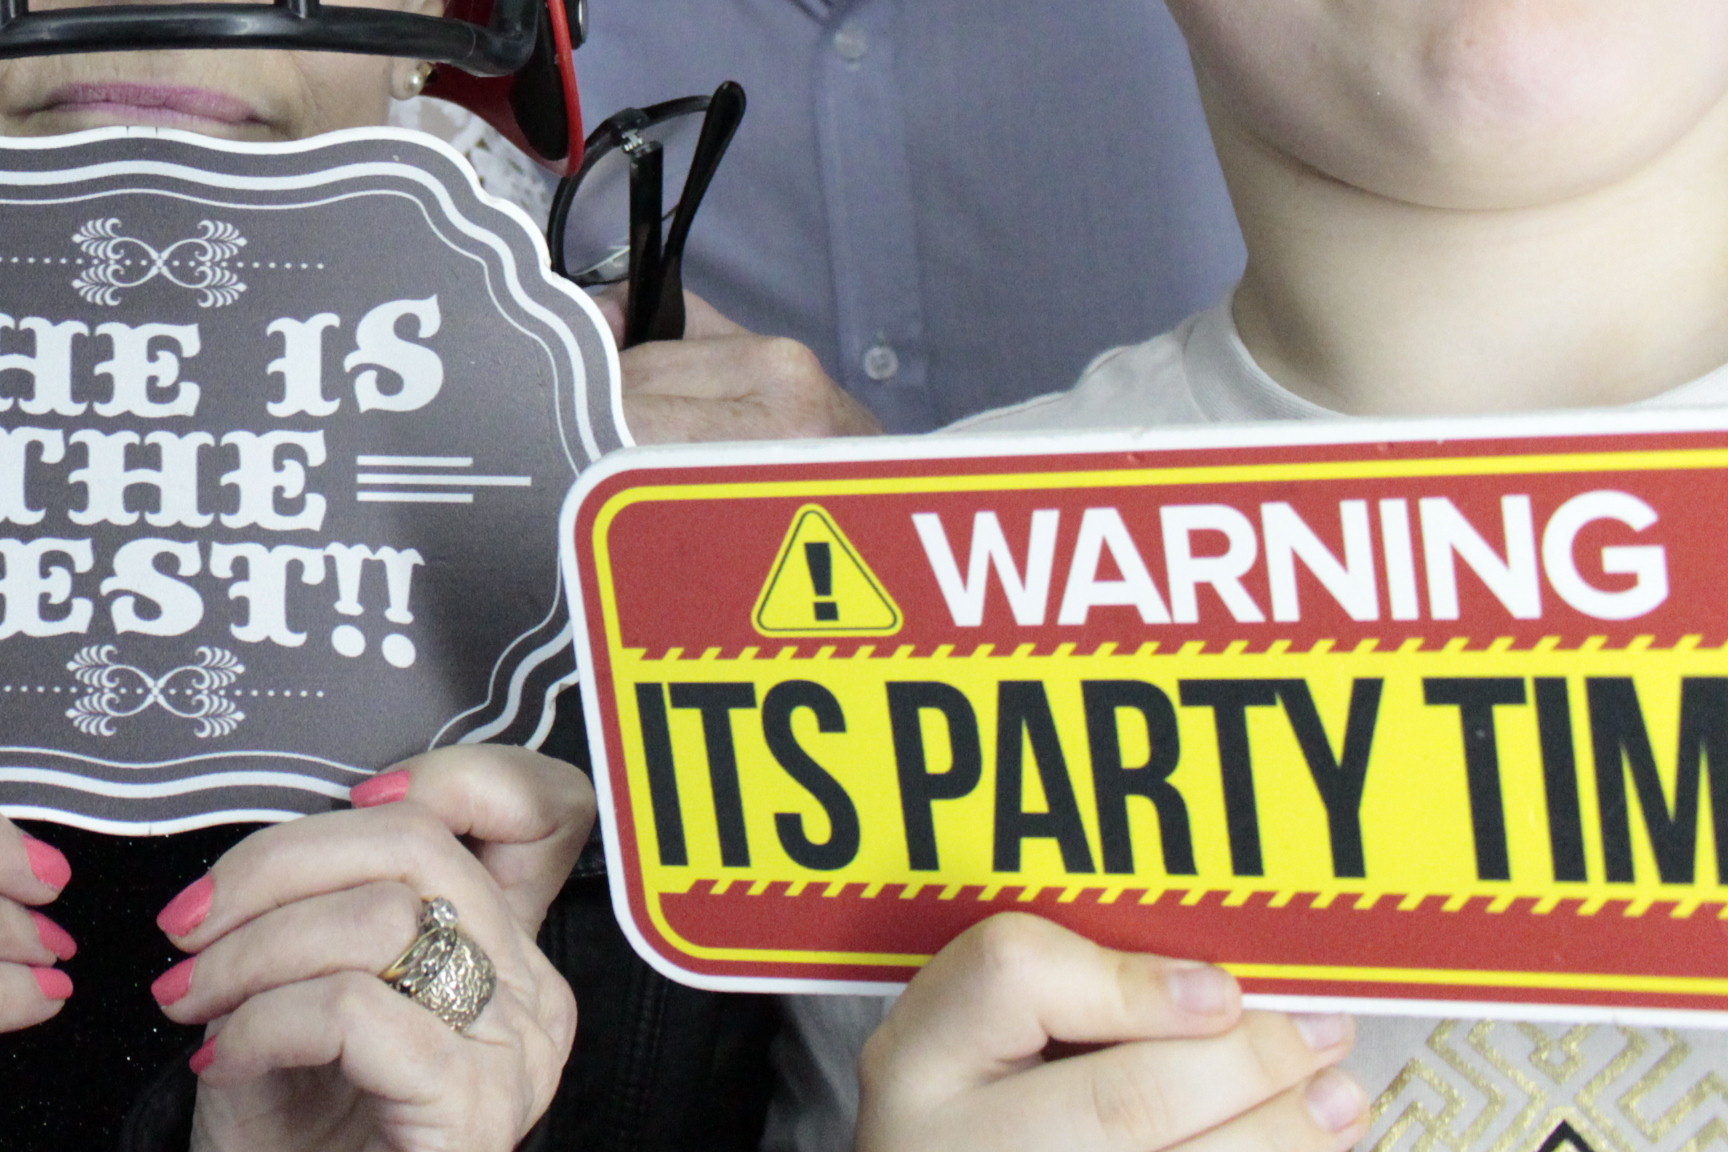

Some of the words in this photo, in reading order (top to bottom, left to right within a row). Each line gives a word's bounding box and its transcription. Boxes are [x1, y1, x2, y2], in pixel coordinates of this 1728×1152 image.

[266, 294, 445, 417] IS
[912, 489, 1670, 627] WARNING
[633, 679, 861, 870] ITS
[886, 677, 1385, 879] PARTY
